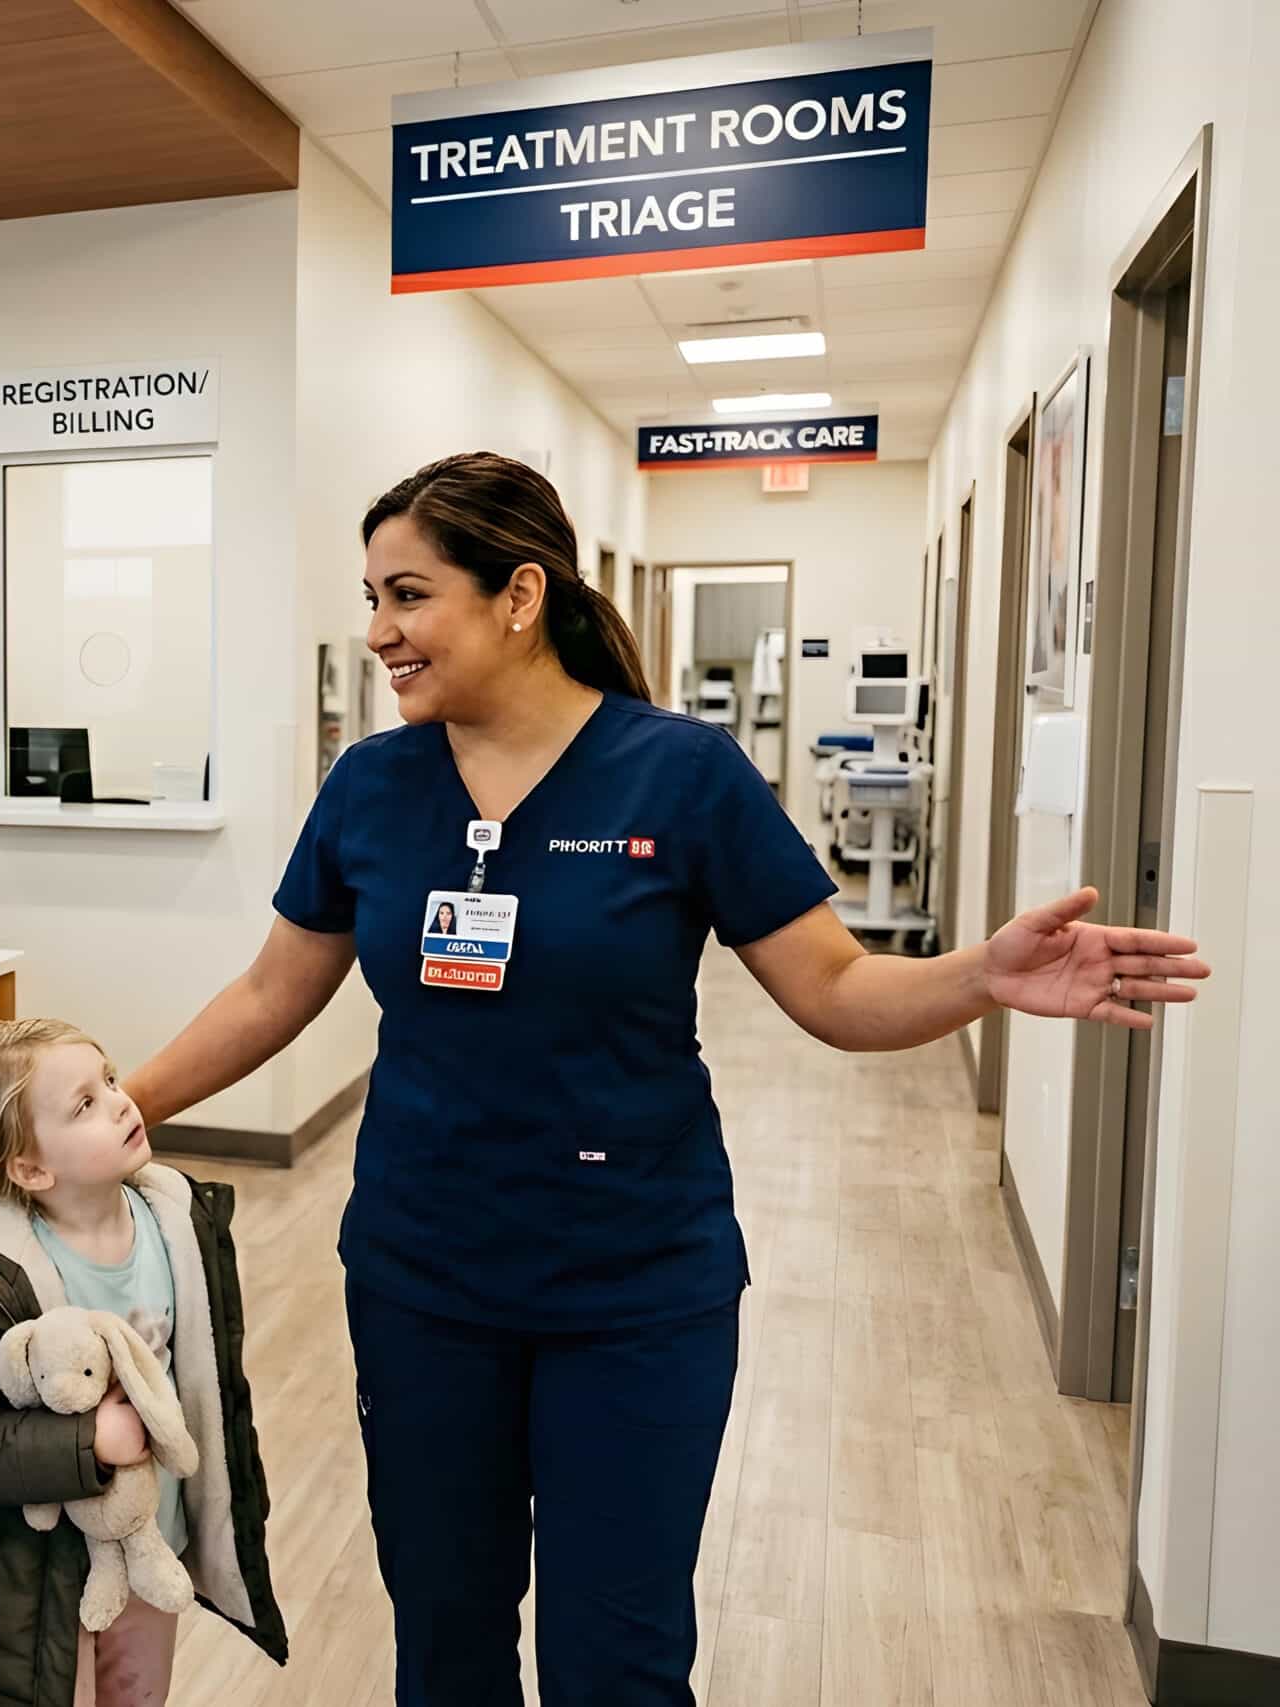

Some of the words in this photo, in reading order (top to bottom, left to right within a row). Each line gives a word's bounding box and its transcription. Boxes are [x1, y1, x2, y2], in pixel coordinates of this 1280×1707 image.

[410, 113, 697, 182] TREATMENT
[710, 89, 907, 149] ROOMS
[560, 187, 736, 241] TRIAGE
[2, 369, 209, 406] REGISTRATION/
[52, 408, 154, 435] BILLING
[649, 427, 794, 454] FAST-TRACK
[797, 425, 865, 449] CARE
